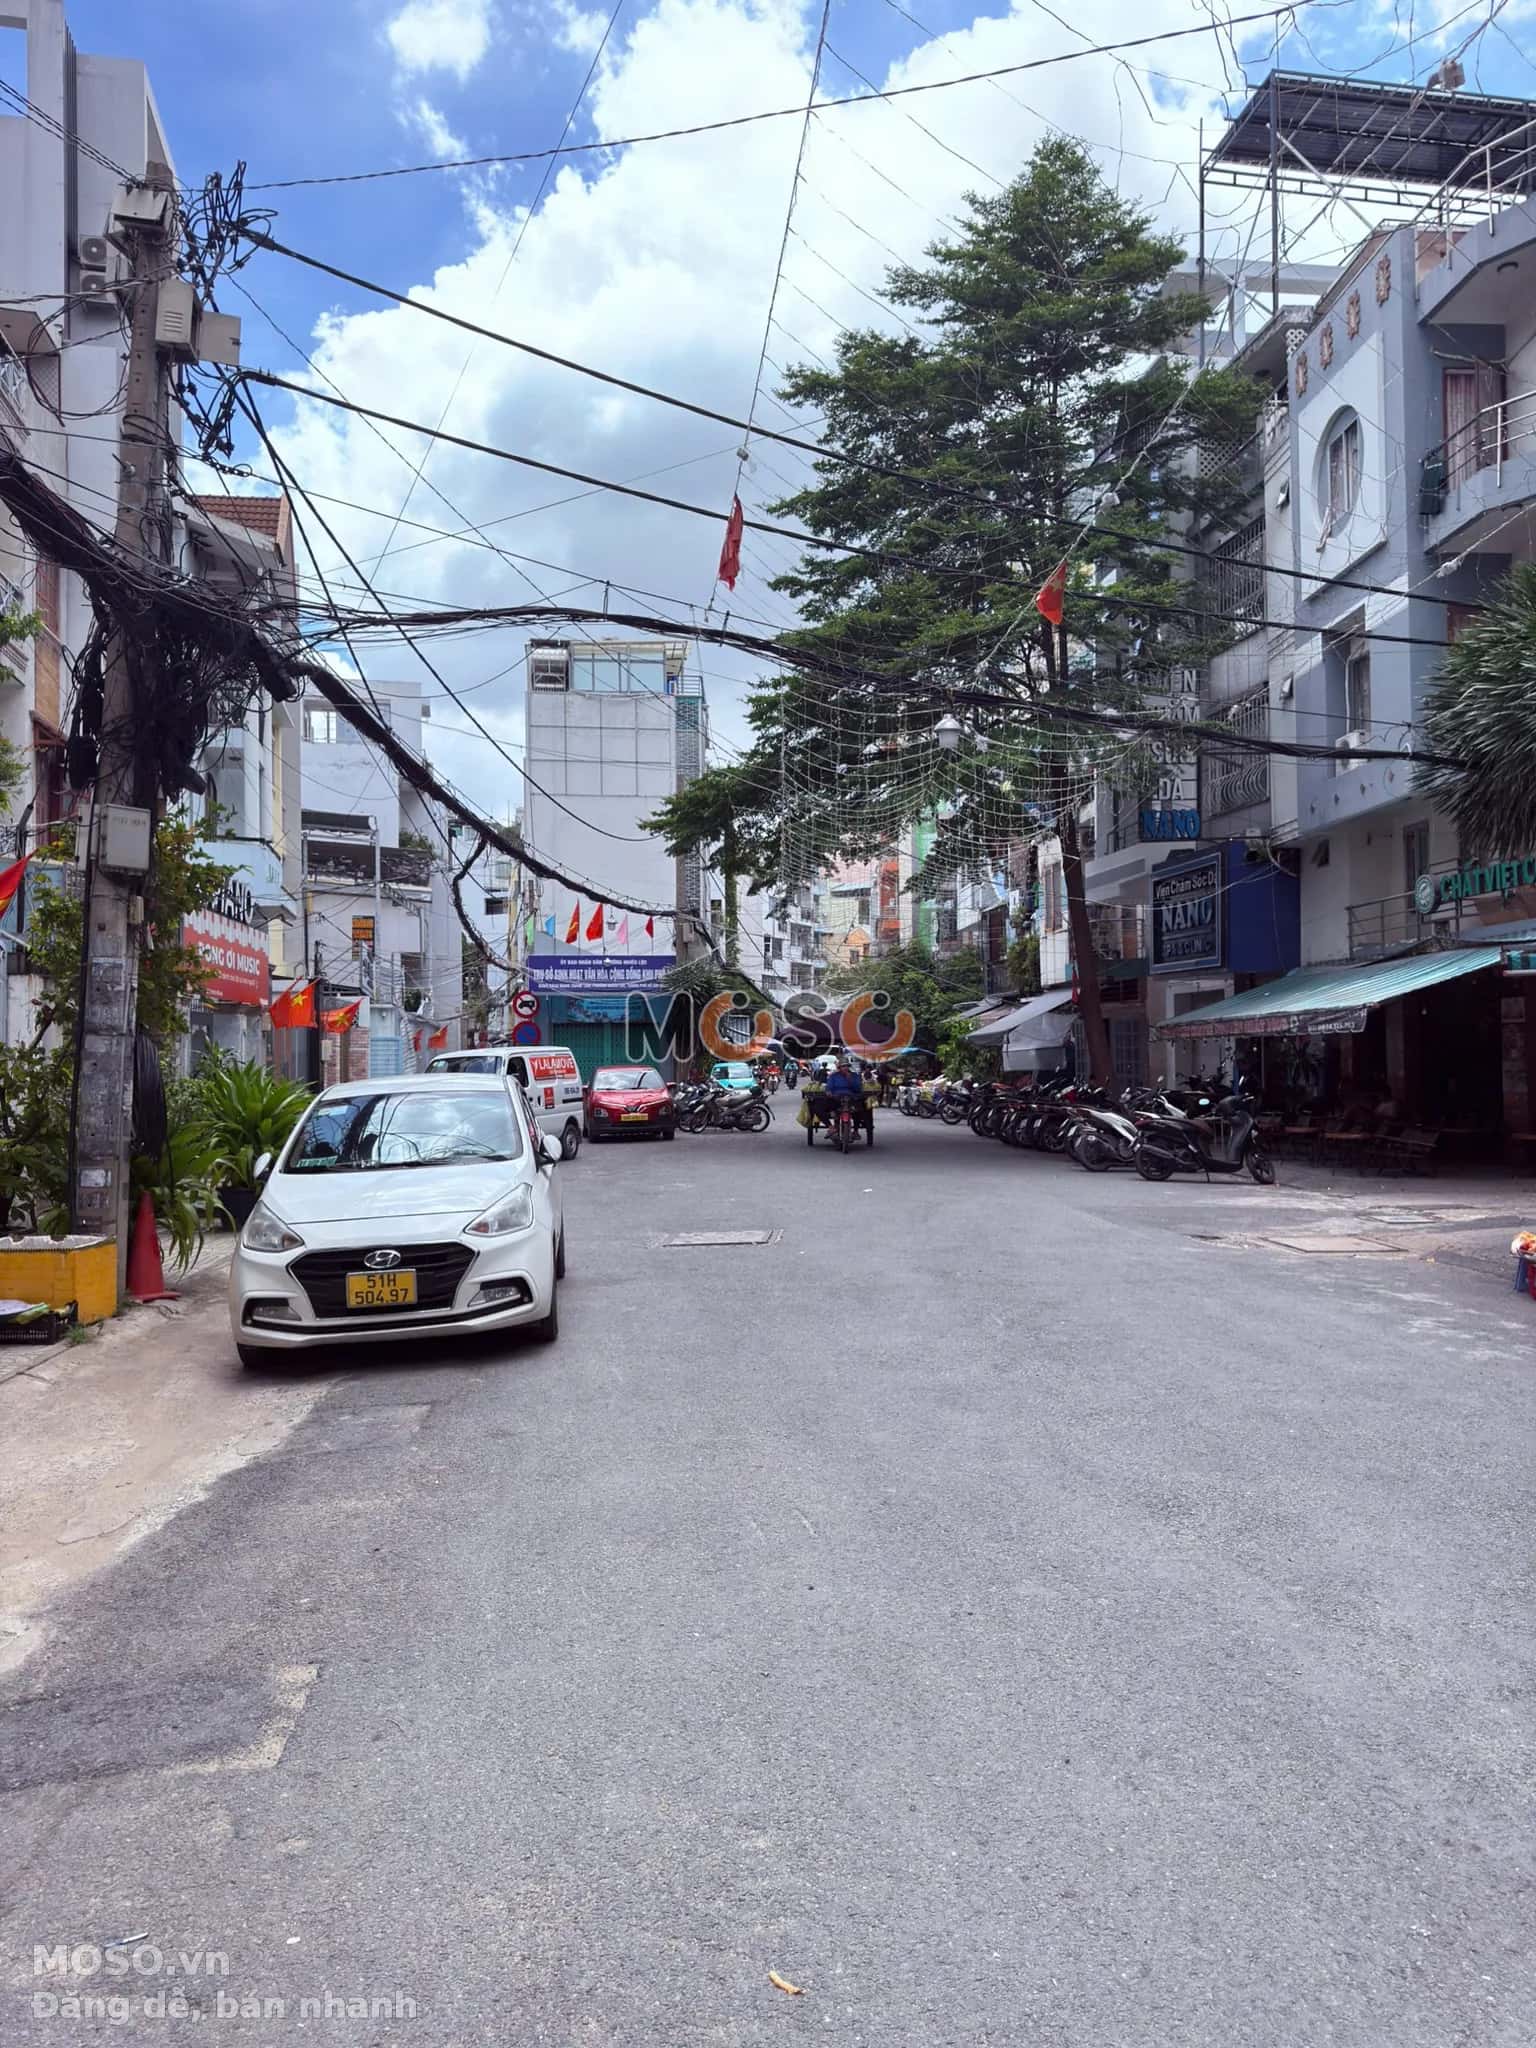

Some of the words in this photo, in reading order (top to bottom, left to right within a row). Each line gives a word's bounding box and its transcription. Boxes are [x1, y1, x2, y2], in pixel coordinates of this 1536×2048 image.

[236, 953, 260, 976] MUSIC
[367, 1273, 397, 1288] 51H
[355, 1288, 409, 1305] 504.97
